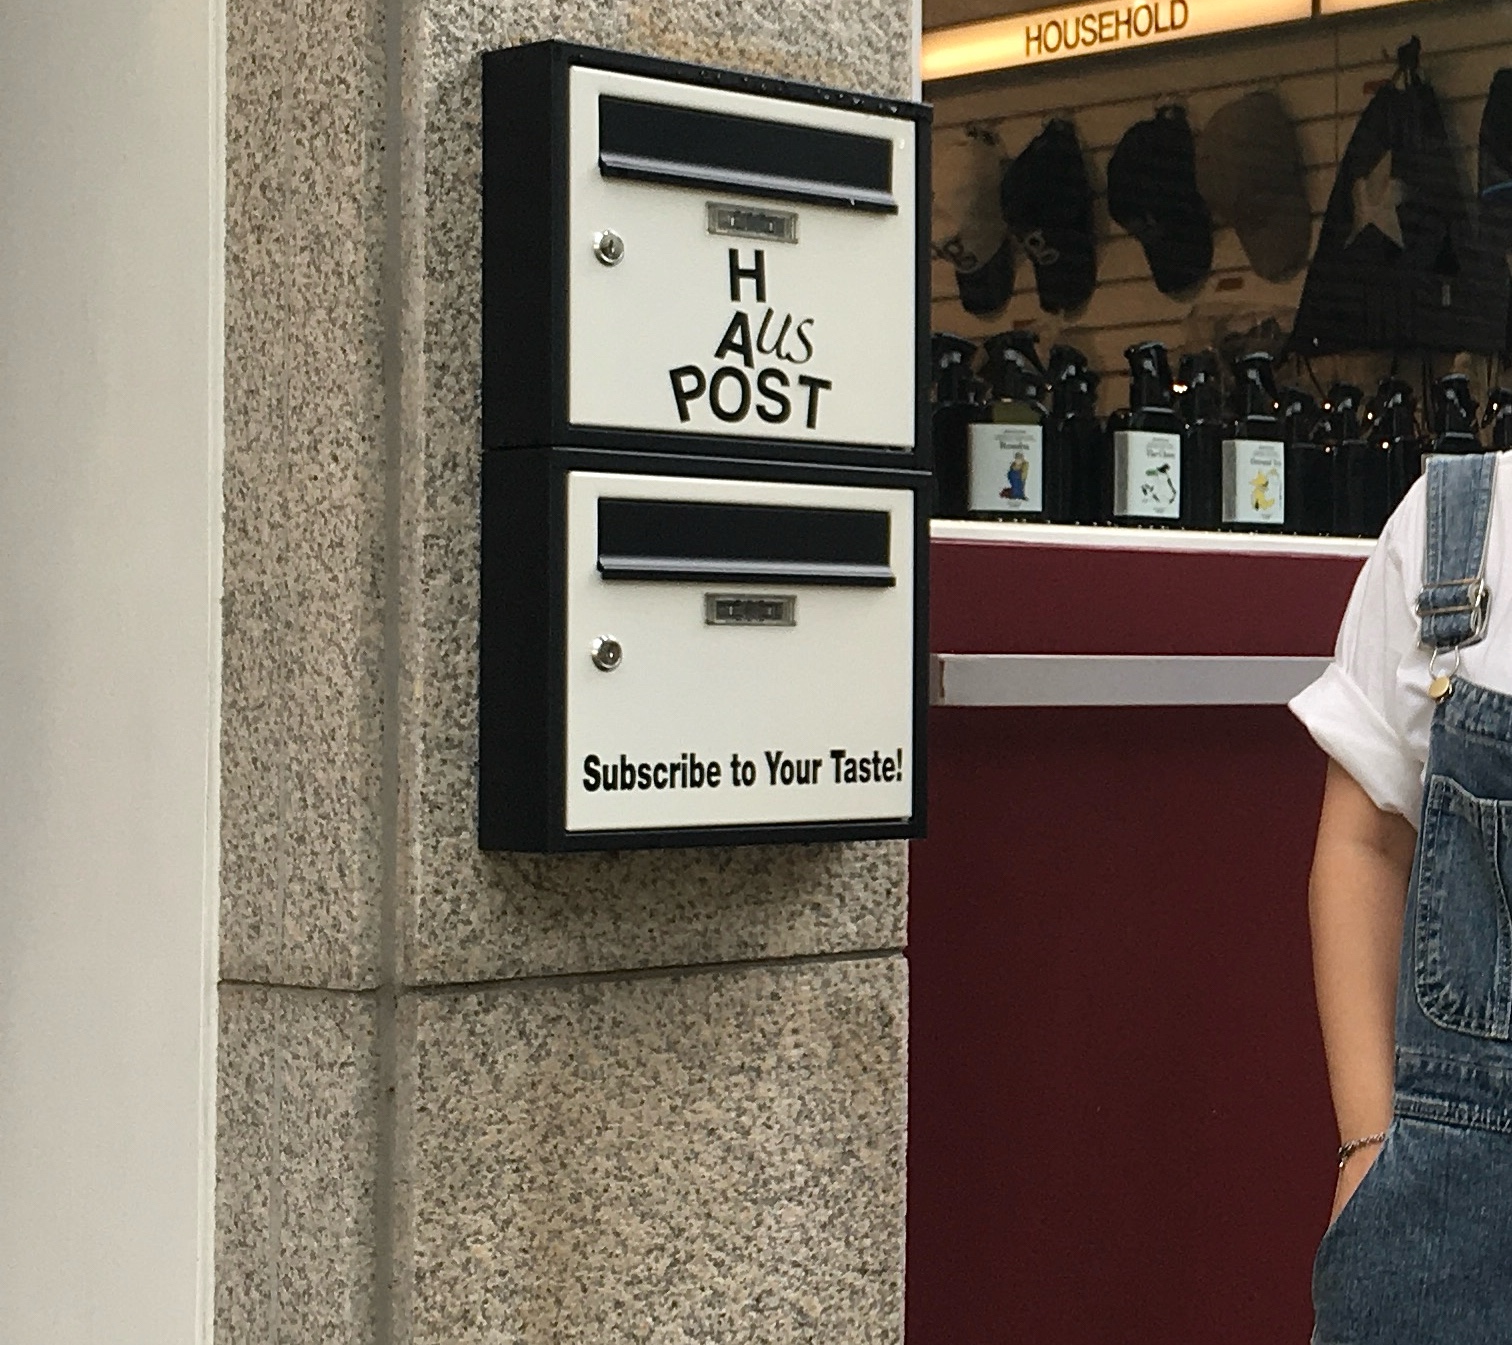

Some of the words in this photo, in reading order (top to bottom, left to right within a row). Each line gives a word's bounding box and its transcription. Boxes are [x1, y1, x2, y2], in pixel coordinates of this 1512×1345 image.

[669, 365, 832, 429] POST
[582, 753, 722, 792] Subscribe
[730, 753, 757, 787] to
[764, 751, 823, 786] Your
[829, 748, 904, 784] Taste!
